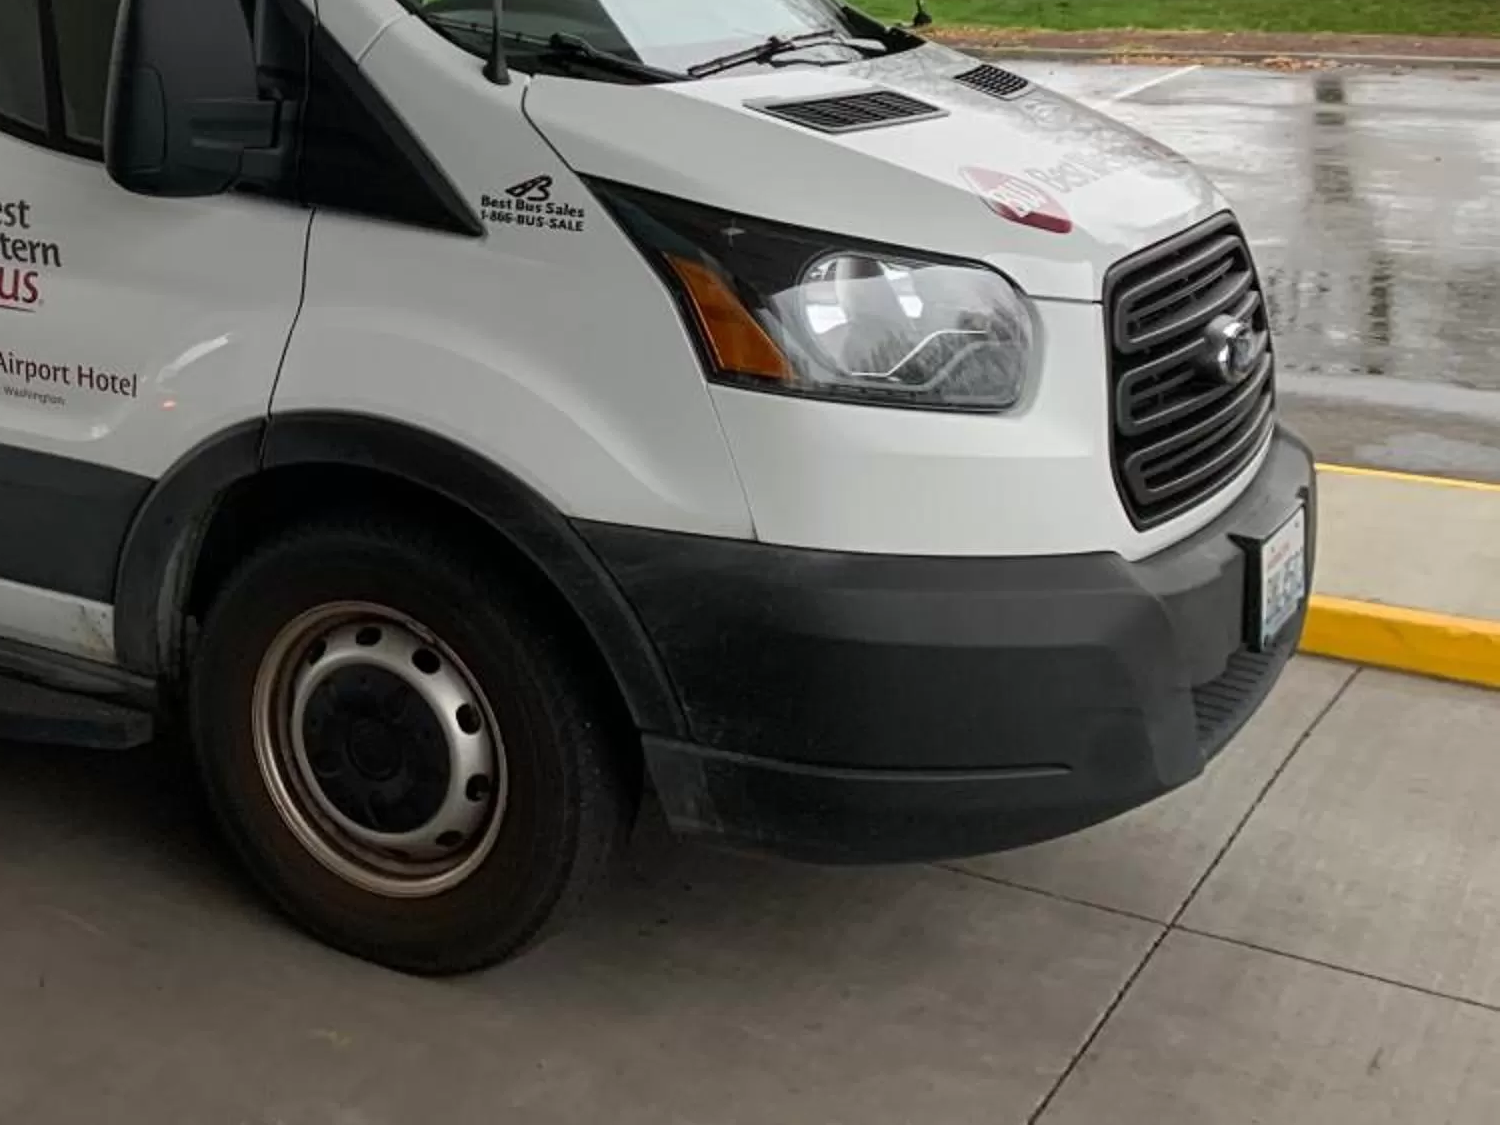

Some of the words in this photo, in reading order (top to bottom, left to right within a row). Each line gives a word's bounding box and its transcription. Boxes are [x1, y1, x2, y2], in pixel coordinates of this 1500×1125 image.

[481, 194, 512, 210] Best
[516, 198, 542, 213] Bus
[545, 202, 585, 218] Sales
[77, 364, 138, 398] Hotel
